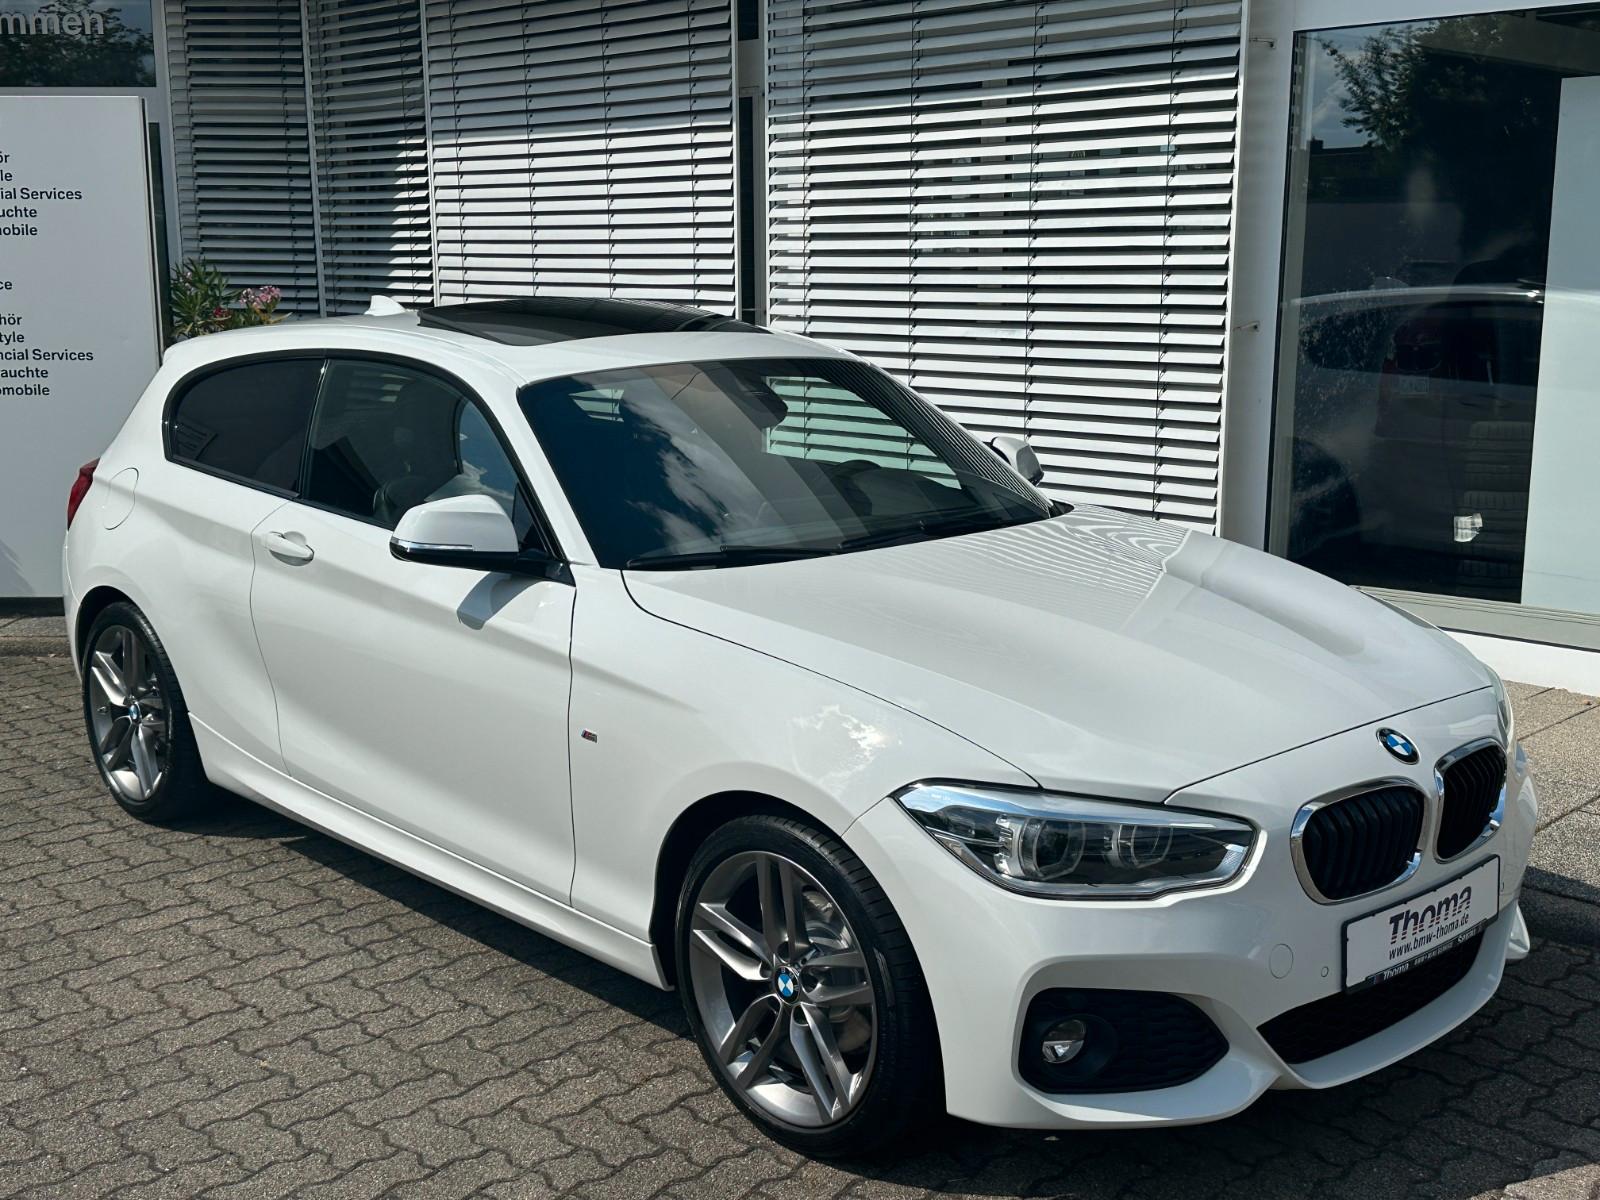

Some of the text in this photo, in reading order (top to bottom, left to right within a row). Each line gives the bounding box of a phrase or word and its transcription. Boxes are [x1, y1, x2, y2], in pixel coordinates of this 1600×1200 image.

[0, 187, 82, 200] ial Services
[0, 223, 38, 236] obile
[32, 348, 94, 361] Services
[0, 366, 49, 379] auchte
[0, 384, 50, 396] mobile
[1389, 886, 1472, 945] Thoma
[1388, 913, 1469, 961] www.bmw-thoma.de
